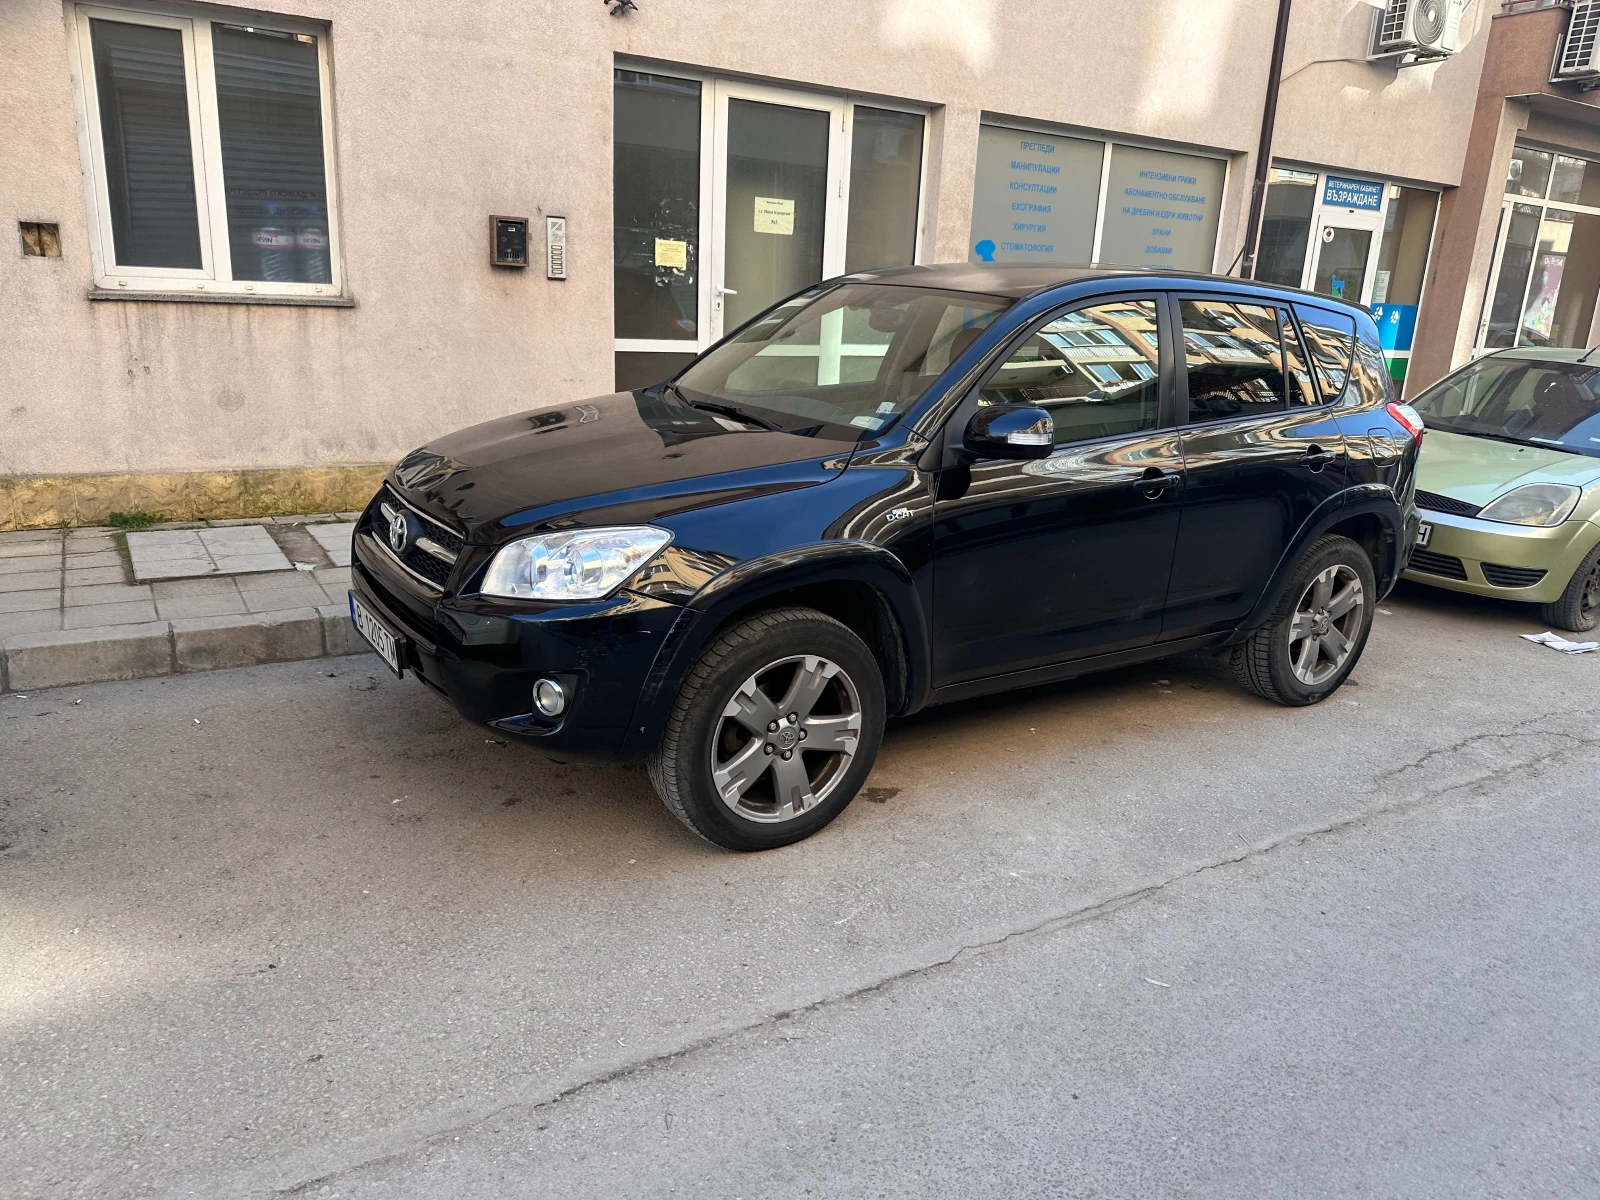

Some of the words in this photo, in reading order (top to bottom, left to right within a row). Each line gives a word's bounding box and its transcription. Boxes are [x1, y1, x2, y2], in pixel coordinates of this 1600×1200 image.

[1020, 140, 1055, 154] ПРЕГЛЕДИ
[1010, 161, 1060, 175] МАНИПУЛАЦИИ
[1139, 170, 1177, 183] ИНТЕНЗИВНИ
[1177, 175, 1197, 185] ГРИЖИ
[1009, 181, 1058, 195] КОНСУЛТАЦИИ
[1328, 180, 1360, 191] ВЕТЕРИНАРЕН
[1360, 184, 1380, 194] КАБИНЕТ
[1124, 187, 1168, 199] АБОНАМЕНТНО
[1168, 192, 1206, 204] ОБСЛУЖВАНЕ
[1326, 189, 1379, 207] ВЪЗРАЖДАНЕ
[1011, 202, 1052, 213] ЕХОГРАФИЯ
[1122, 206, 1131, 214] НА
[1131, 207, 1155, 217] ДРЕБНИ
[1155, 210, 1160, 218] И
[1160, 210, 1176, 219] ЕДРИ
[1176, 212, 1204, 222] ЖИВОТНИ
[1013, 222, 1047, 233] ХИРУРГИЯ
[1152, 228, 1172, 236] ХРАНИ
[1001, 242, 1054, 253] СТОМАТОЛОГИЯ
[1145, 245, 1173, 254] ДОБАВКИ
